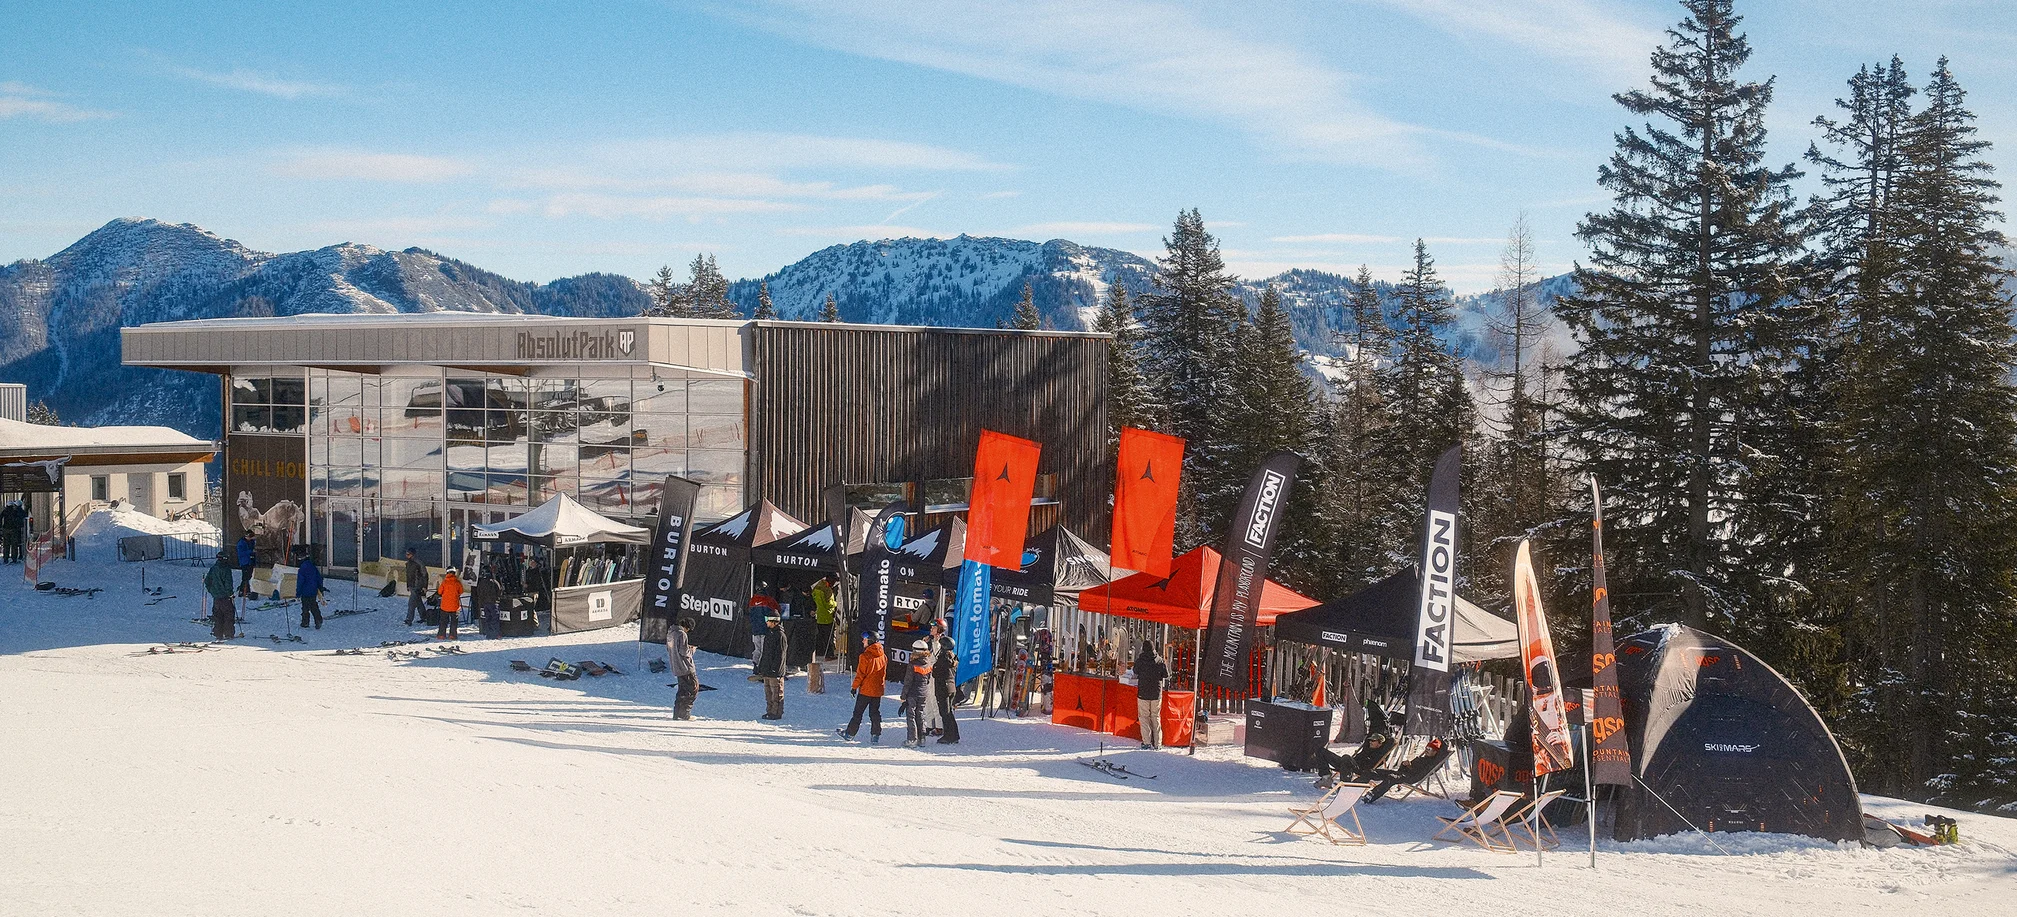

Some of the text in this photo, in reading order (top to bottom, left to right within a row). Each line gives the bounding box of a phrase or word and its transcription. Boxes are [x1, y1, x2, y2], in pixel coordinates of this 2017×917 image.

[517, 329, 615, 358] AbsolutPark
[620, 331, 634, 354] AP
[232, 458, 271, 477] CHILL
[1249, 473, 1281, 544] FACTION
[690, 543, 728, 557] BURTON
[1065, 554, 1105, 565] SNOW
[654, 514, 683, 608] BURTON
[776, 554, 819, 568] BURTON
[1012, 587, 1029, 597] RIDE
[1422, 517, 1451, 664] FACTION
[1232, 599, 1248, 614] MY
[1230, 612, 1245, 623] IS
[1223, 621, 1244, 661] MOUNTAIN
[1322, 631, 1347, 642] FACTION
[1219, 659, 1235, 678] THE
